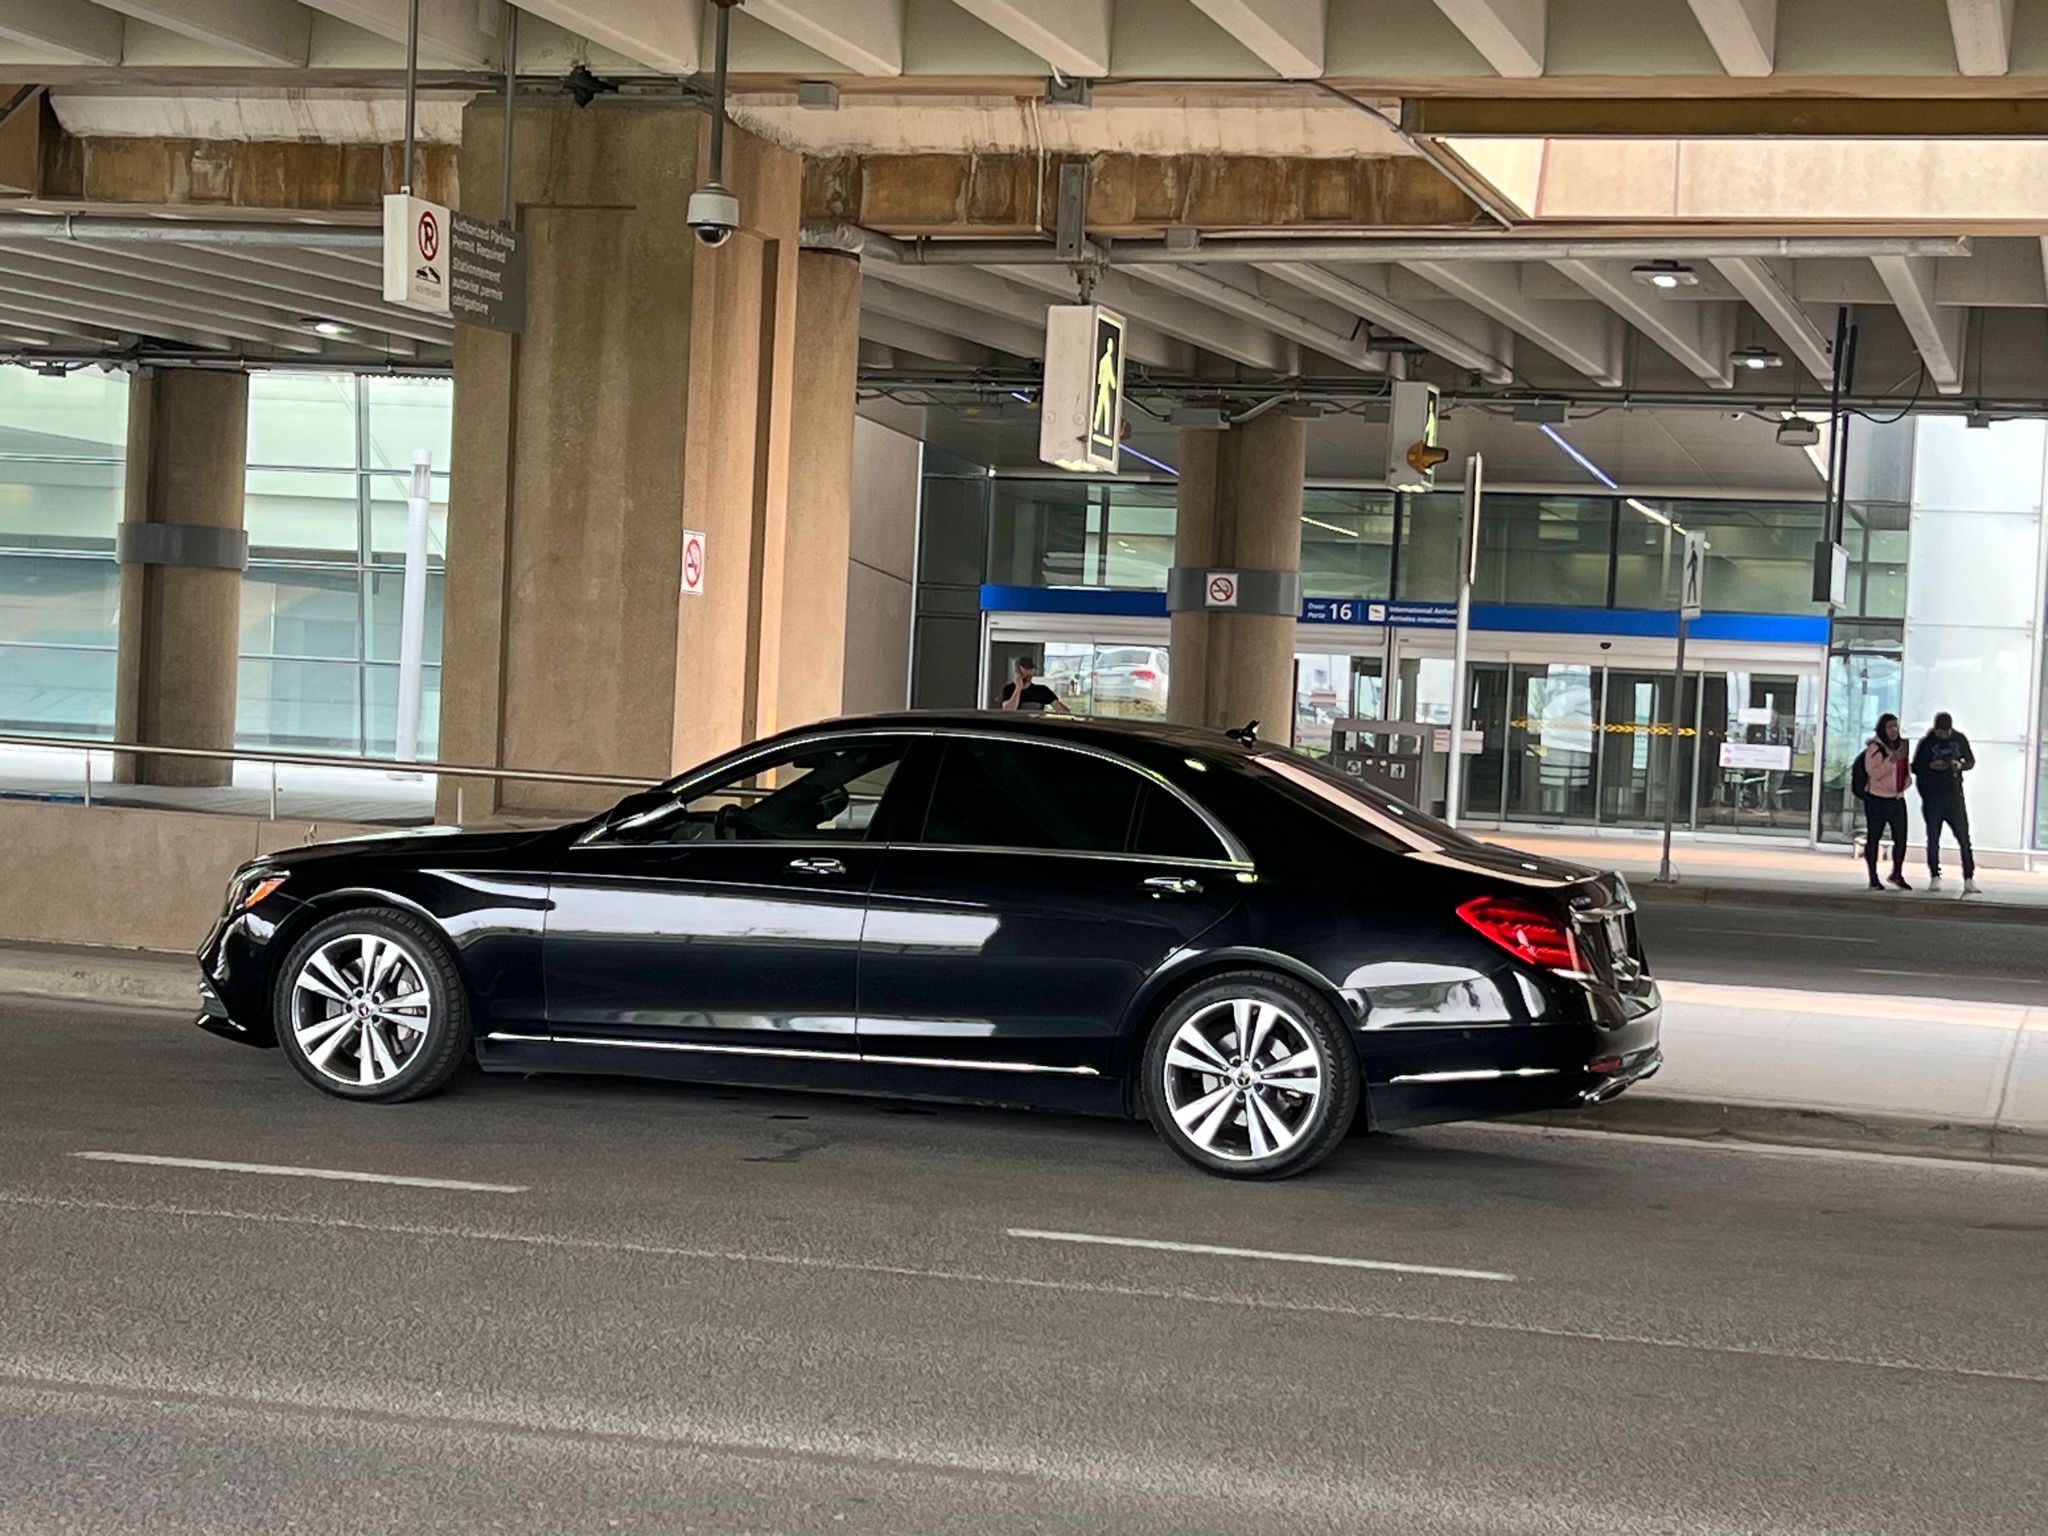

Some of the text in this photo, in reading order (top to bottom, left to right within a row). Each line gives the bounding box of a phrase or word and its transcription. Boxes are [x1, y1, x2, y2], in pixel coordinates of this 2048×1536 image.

[452, 217, 516, 251] Authorized Parking
[452, 234, 506, 263] Permit Required
[1329, 603, 1352, 621] 16
